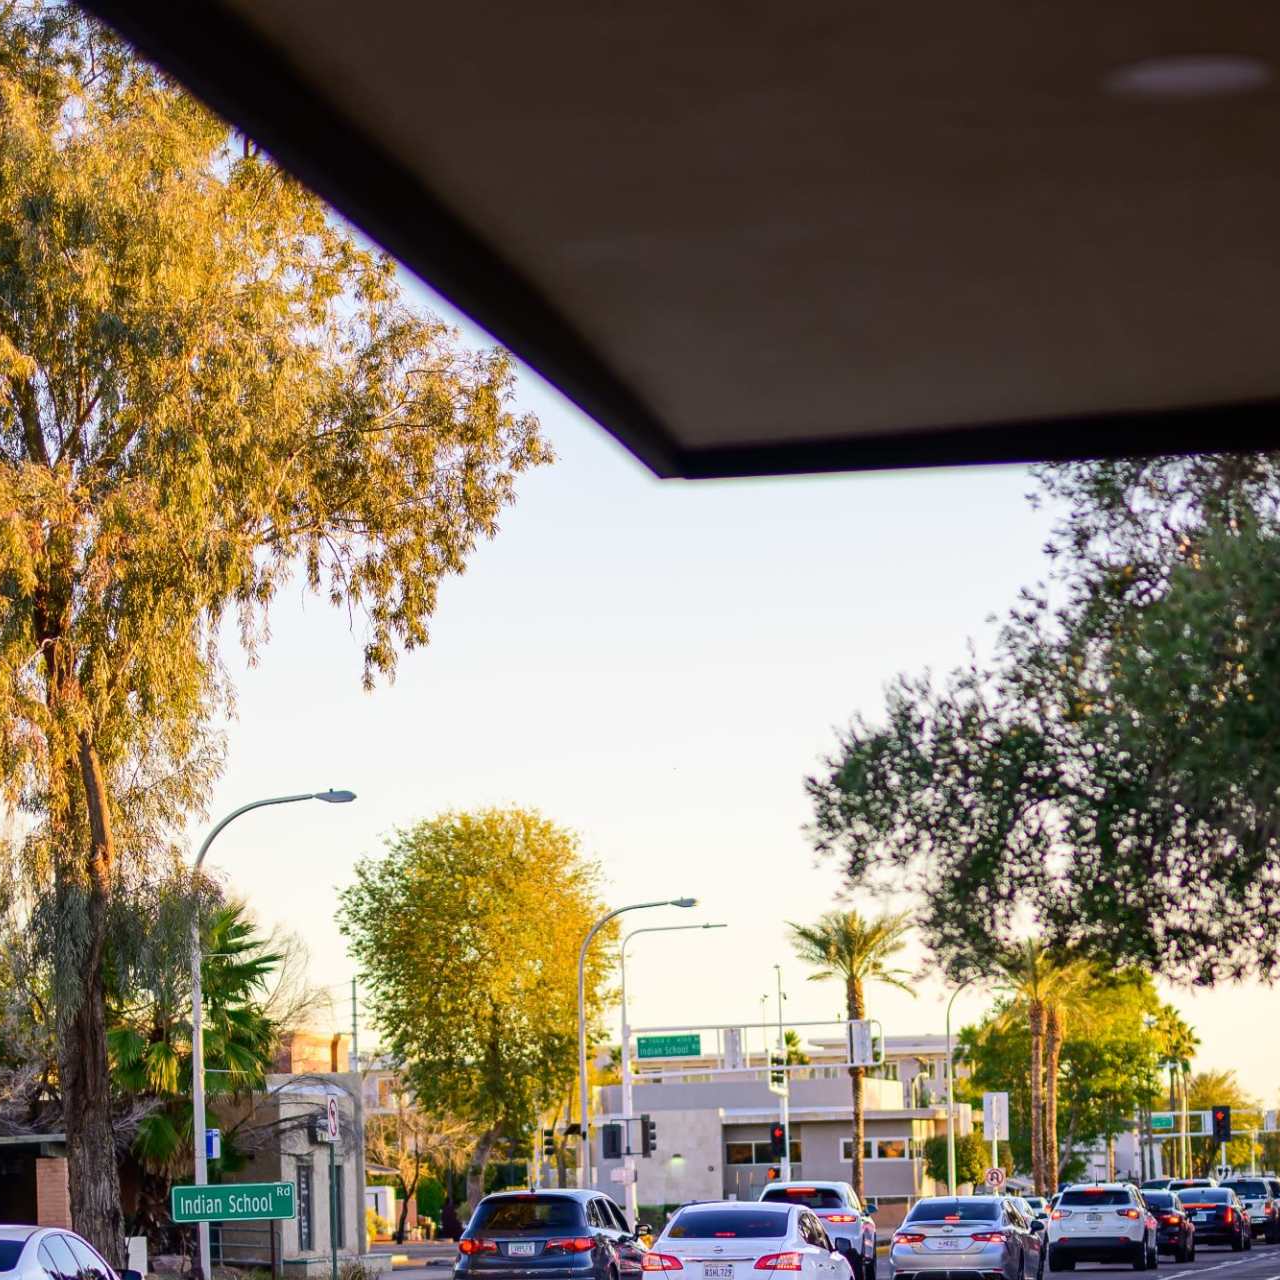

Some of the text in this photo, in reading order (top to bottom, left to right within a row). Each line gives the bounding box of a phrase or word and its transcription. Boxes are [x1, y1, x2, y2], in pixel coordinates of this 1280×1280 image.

[180, 1186, 291, 1215] Indian School Rd
